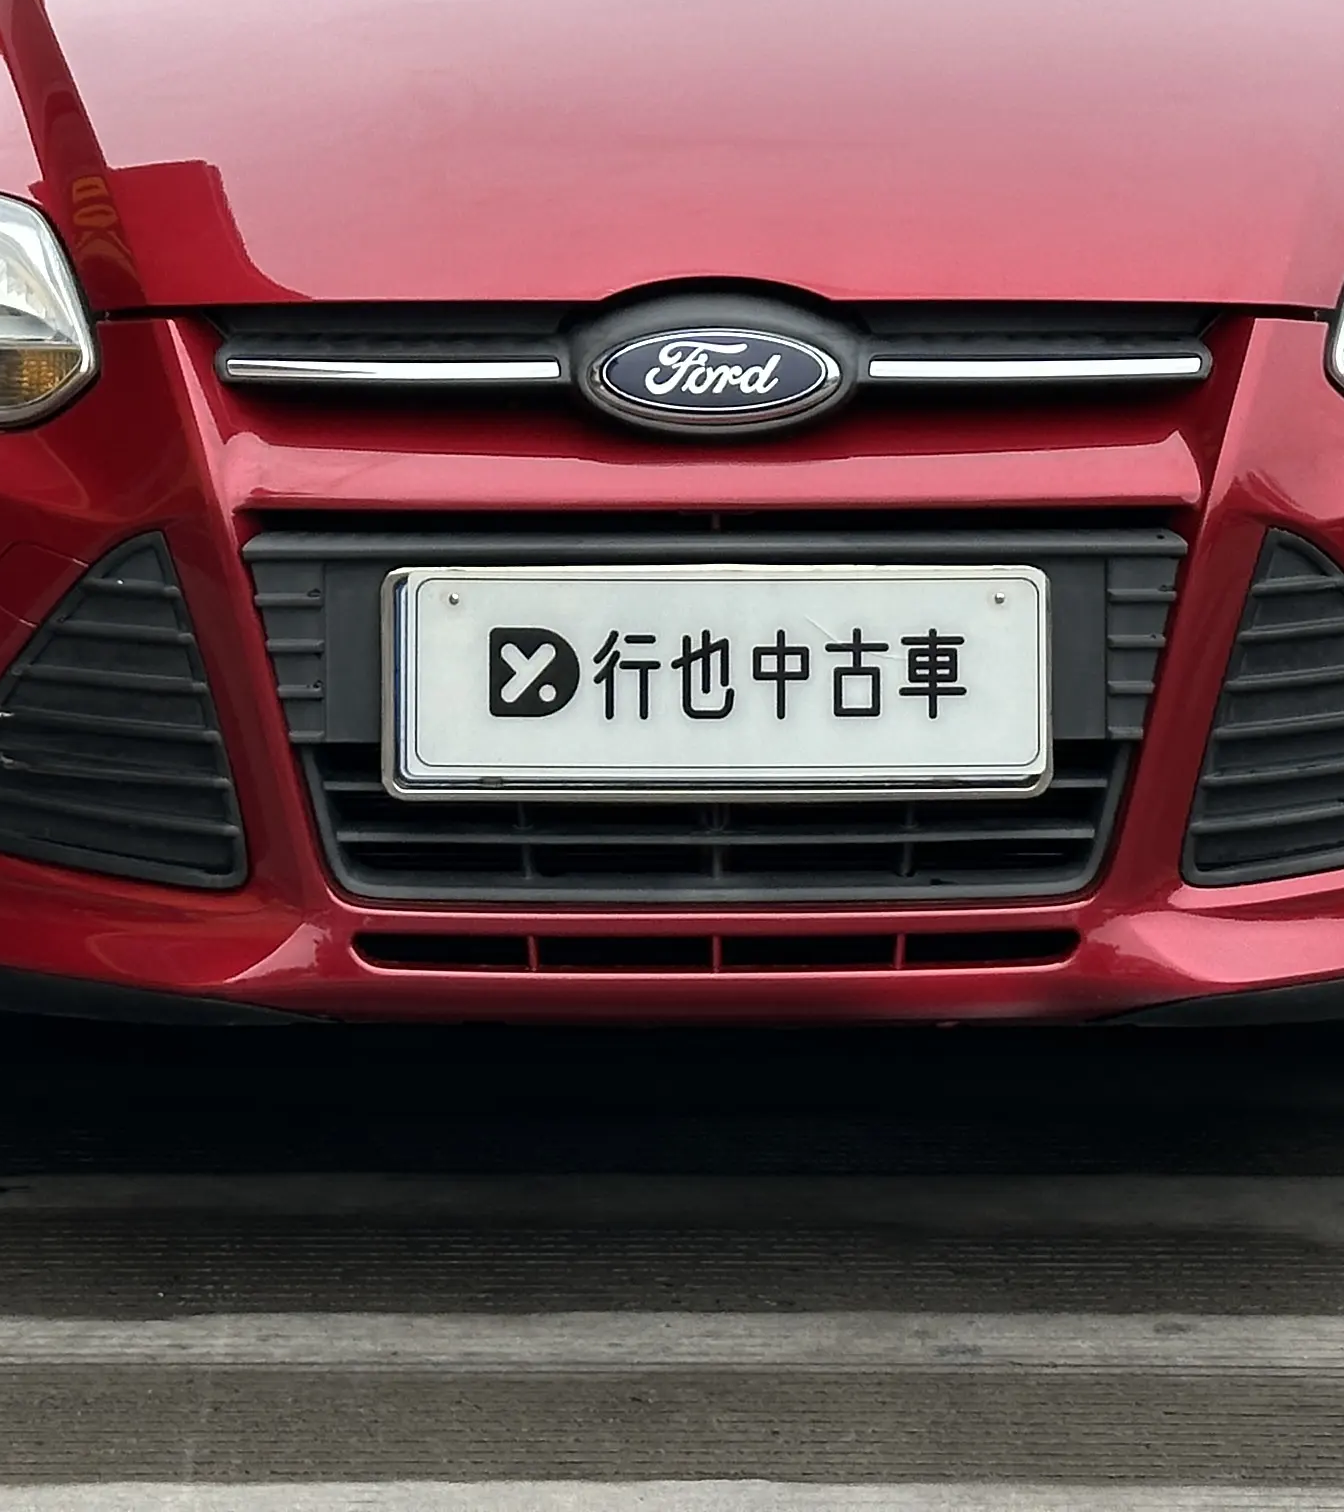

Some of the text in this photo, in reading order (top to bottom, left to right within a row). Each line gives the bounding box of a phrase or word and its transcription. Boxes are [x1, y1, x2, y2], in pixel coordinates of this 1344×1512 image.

[644, 340, 782, 395] Ford
[592, 628, 967, 720] 行也中古車
